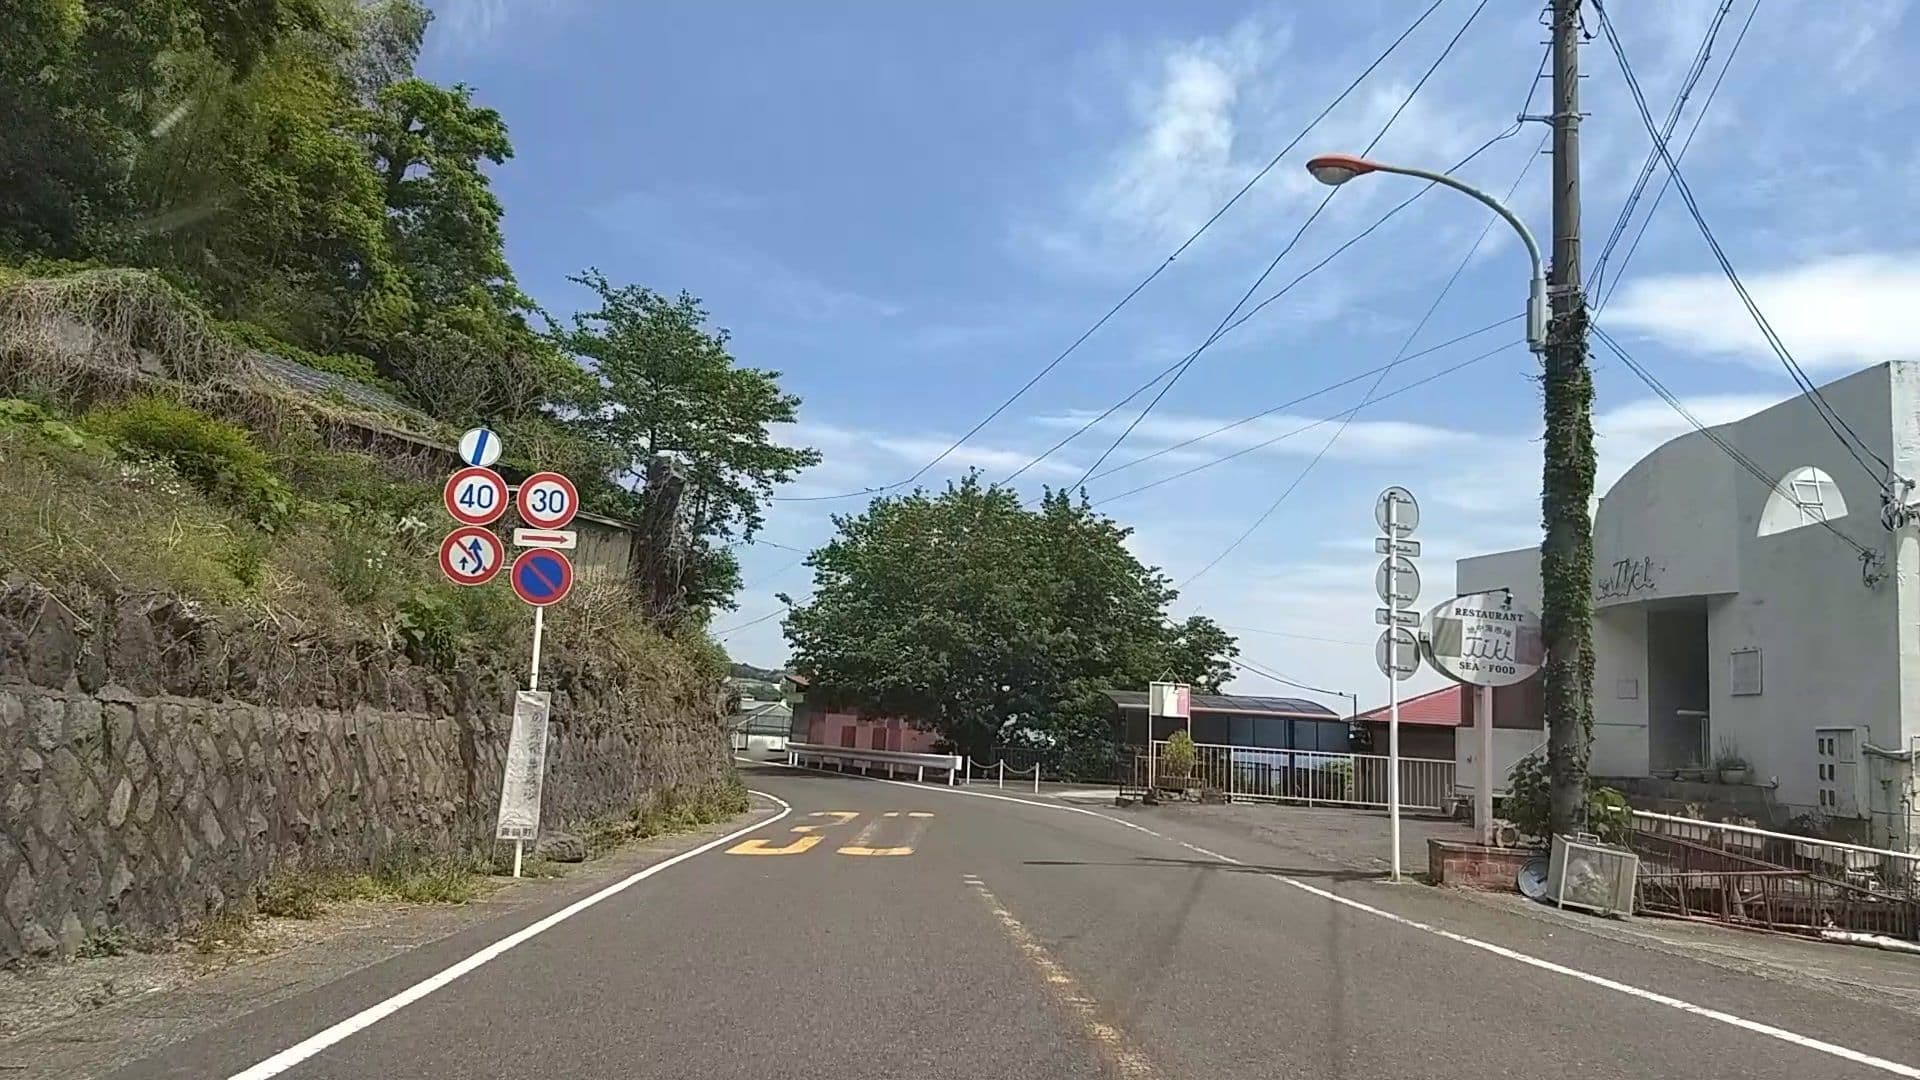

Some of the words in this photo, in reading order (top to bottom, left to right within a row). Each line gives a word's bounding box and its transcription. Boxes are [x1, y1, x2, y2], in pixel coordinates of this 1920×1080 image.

[459, 483, 494, 509] 40
[532, 488, 565, 514] 30
[1455, 607, 1525, 622] RESTAURANT
[1462, 635, 1514, 662] Tiki
